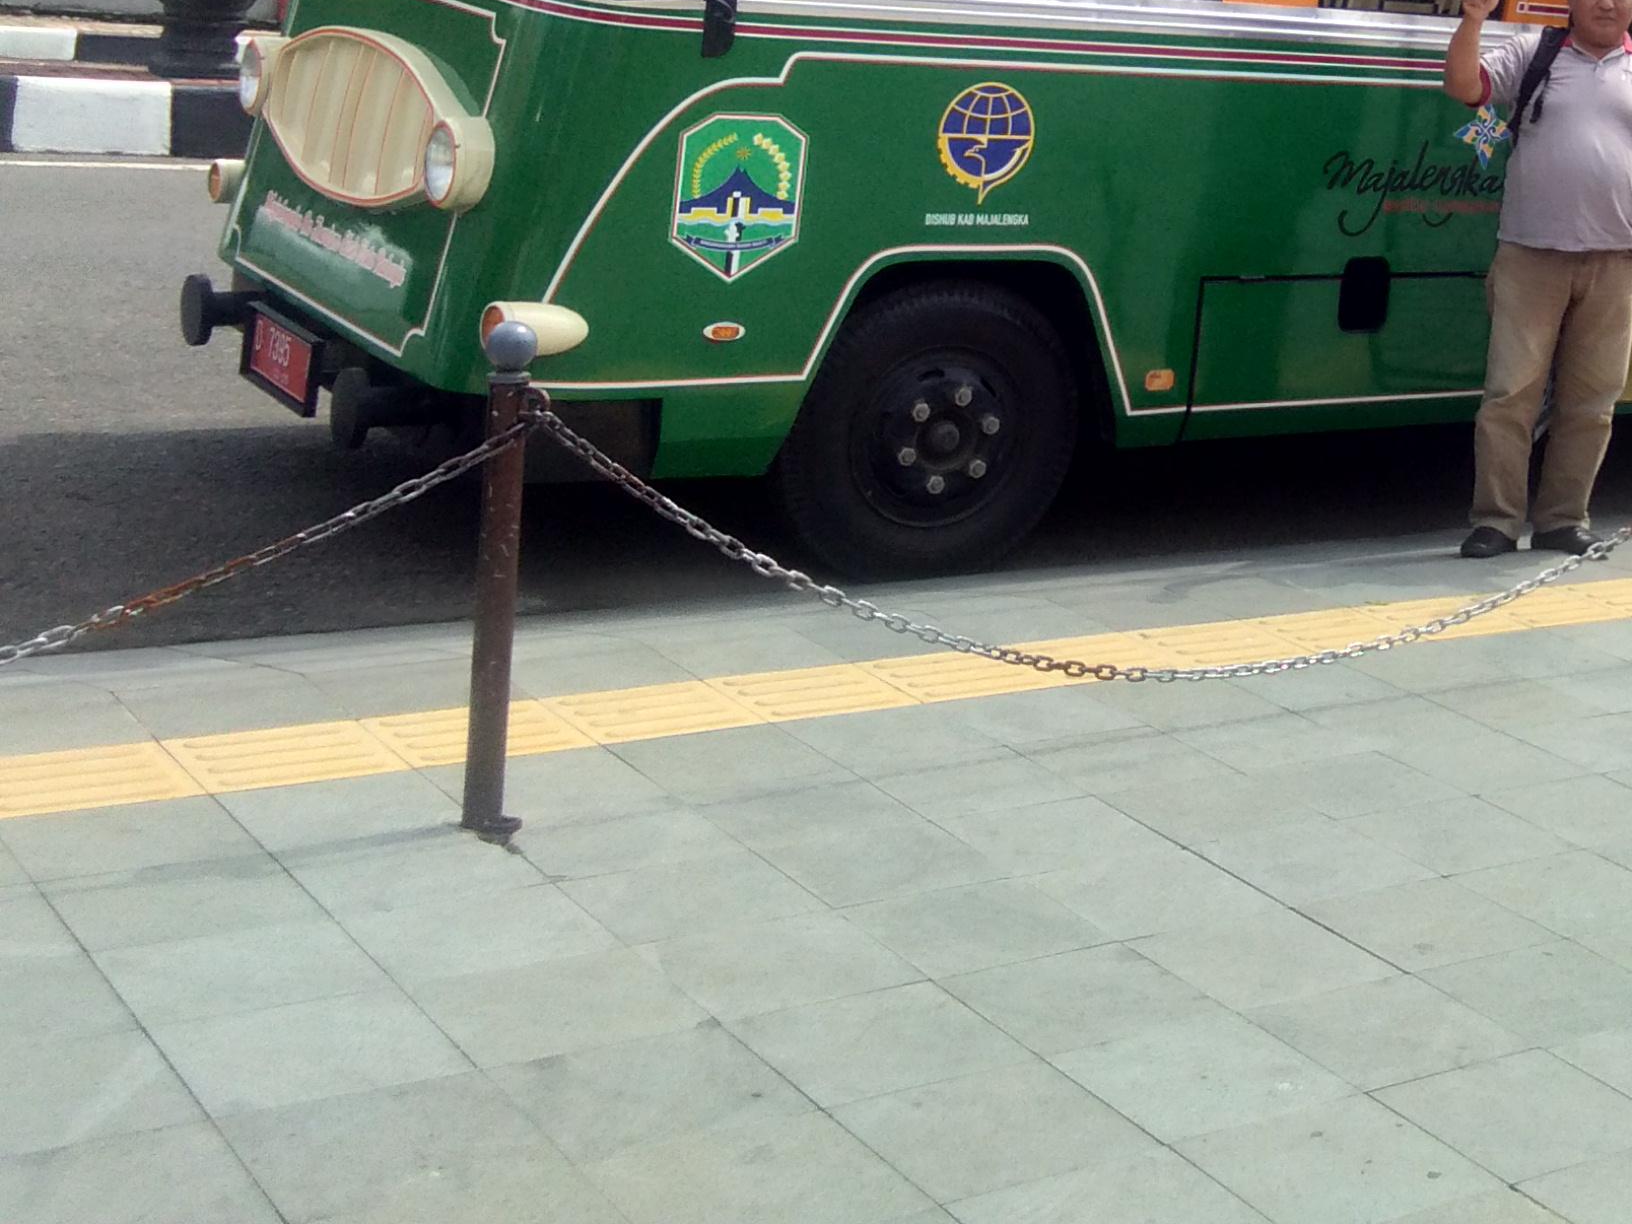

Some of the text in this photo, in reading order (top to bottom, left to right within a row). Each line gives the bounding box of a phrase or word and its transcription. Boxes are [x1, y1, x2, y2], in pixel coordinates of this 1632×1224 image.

[925, 213, 1029, 226] DISHUB KAB MAJALENGKA
